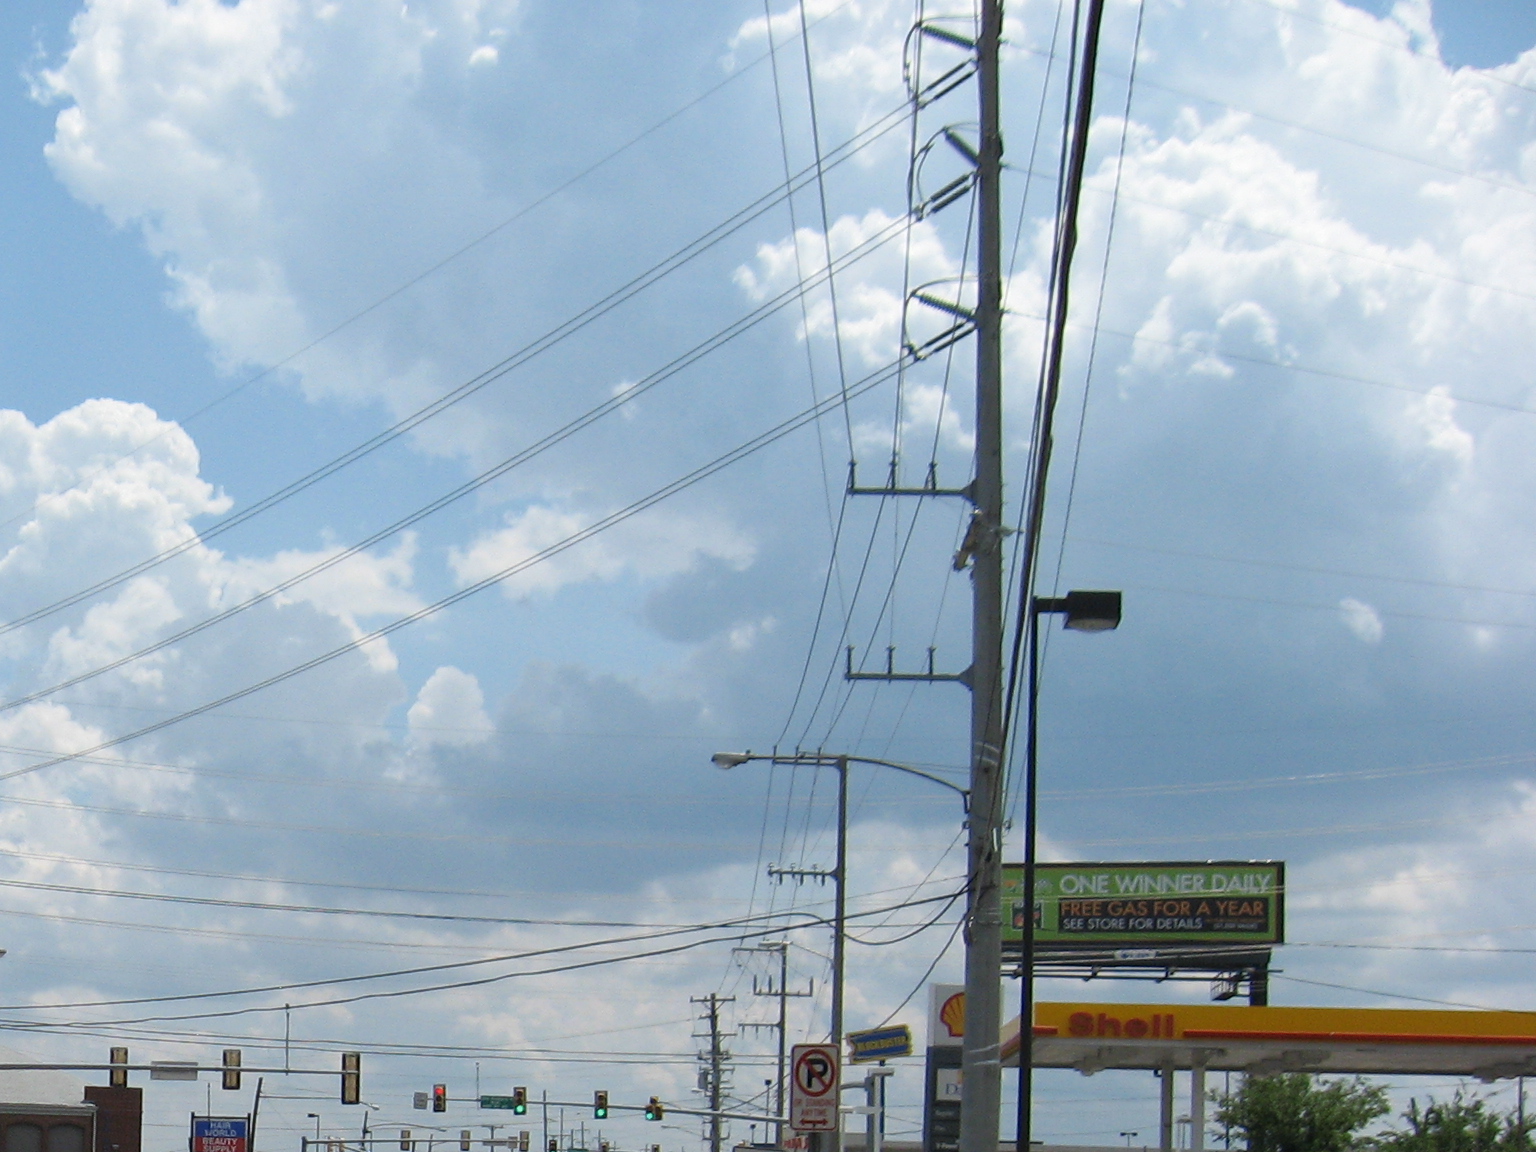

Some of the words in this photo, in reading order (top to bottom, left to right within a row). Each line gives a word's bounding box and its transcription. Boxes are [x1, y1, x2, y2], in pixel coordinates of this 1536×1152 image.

[1059, 874, 1109, 894] ONE
[1116, 873, 1204, 894] WINNER
[1211, 872, 1273, 893] DAILY
[1061, 901, 1104, 917] FREE
[1107, 901, 1149, 917] GAS
[1154, 901, 1190, 917] FOR
[1196, 901, 1210, 916] A
[1215, 900, 1264, 916] YEAR
[1063, 918, 1084, 930] SEE
[1087, 918, 1125, 930] STORE
[1128, 918, 1154, 930] FOR
[1156, 917, 1203, 930] DETAILS
[1068, 1011, 1174, 1037] Shell
[210, 1121, 231, 1129] HAIR
[204, 1129, 237, 1137] WORLD
[202, 1137, 238, 1145] BEAUTY
[202, 1145, 237, 1152] SUPPLY
